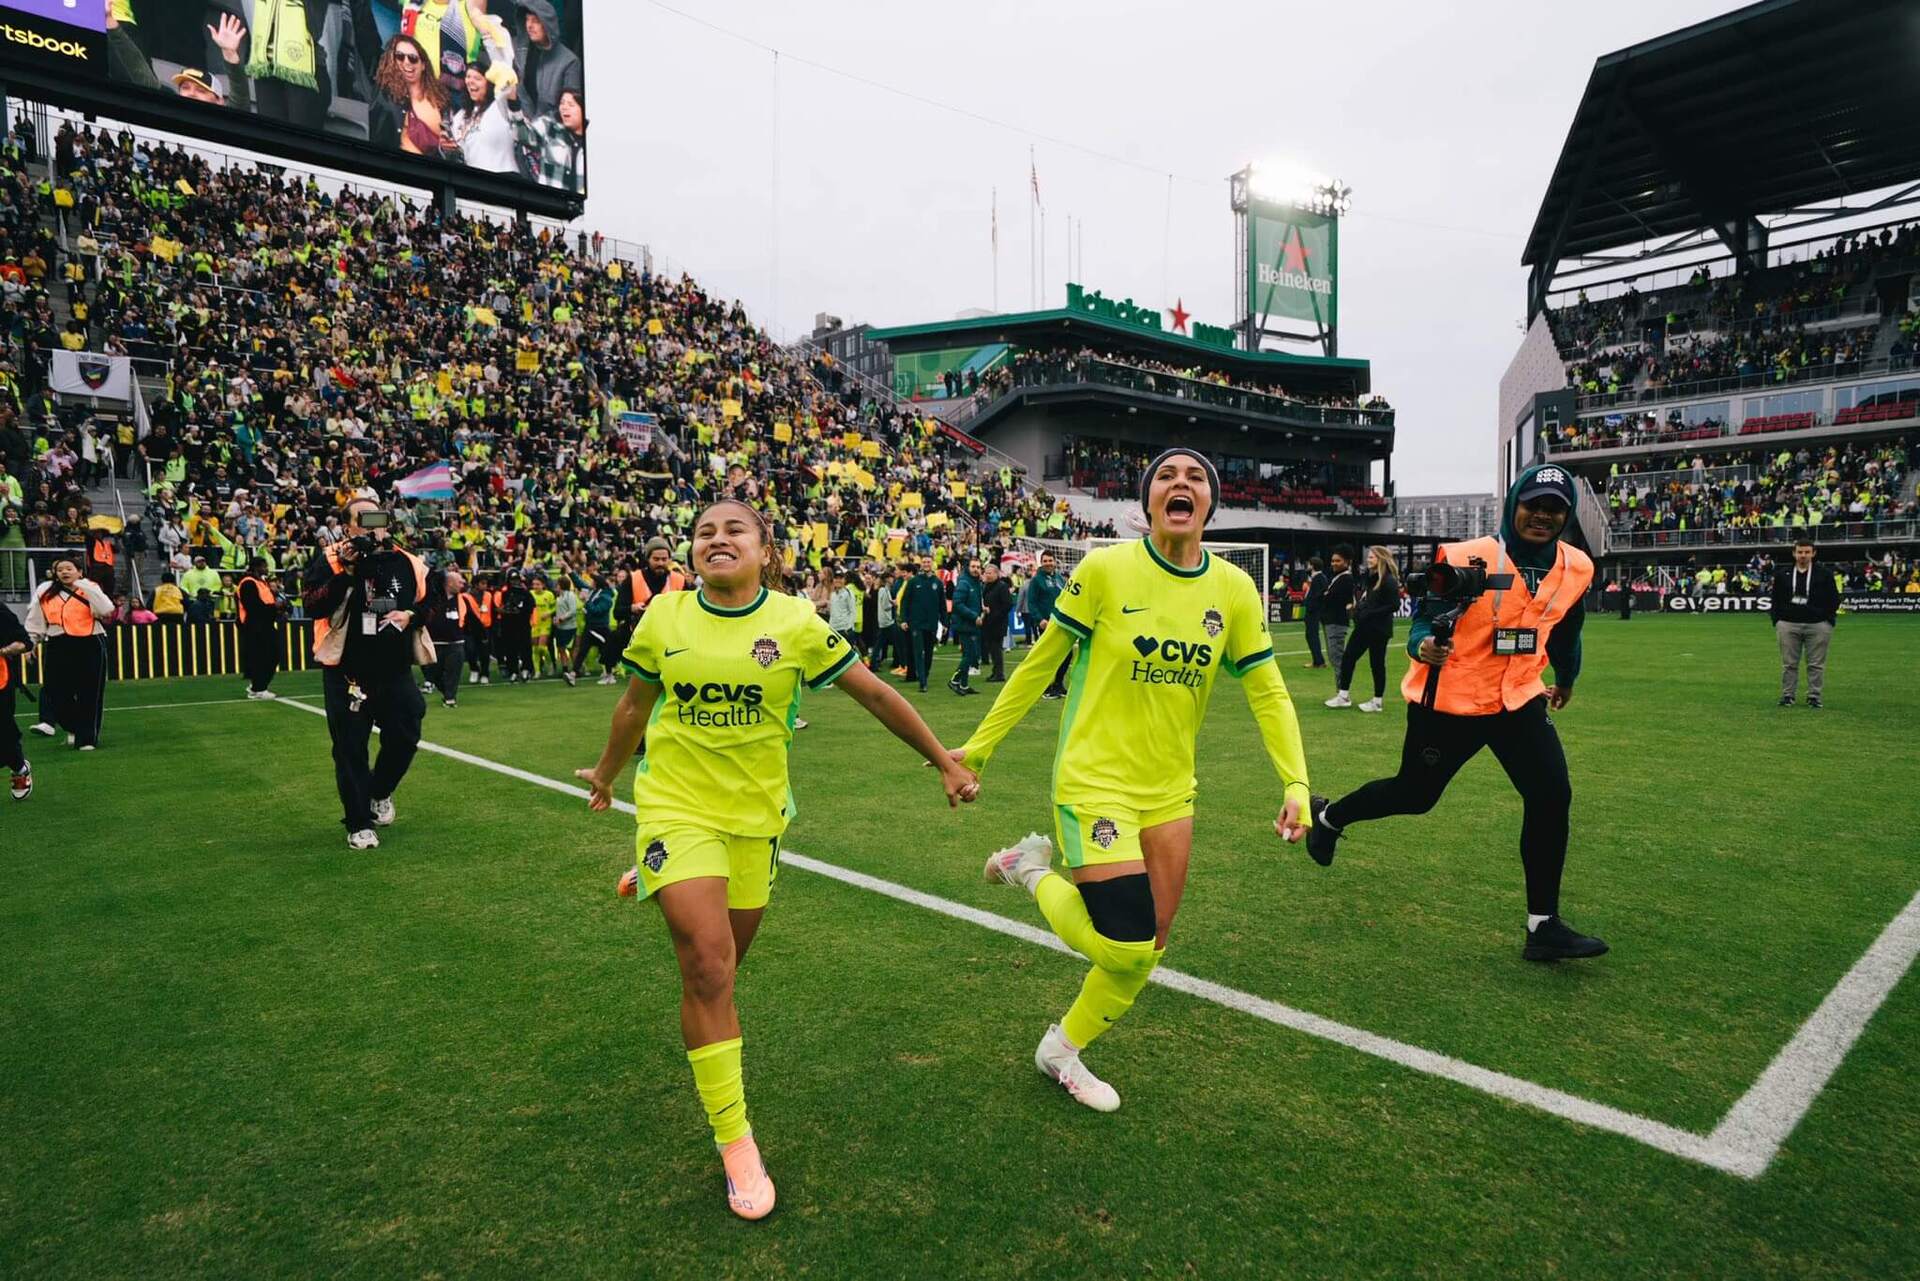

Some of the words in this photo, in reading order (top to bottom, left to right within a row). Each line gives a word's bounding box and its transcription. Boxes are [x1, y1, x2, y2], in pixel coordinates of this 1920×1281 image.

[1258, 262, 1332, 295] Heineken
[1881, 603, 1914, 611] Planning
[1161, 639, 1213, 667] CVS
[1130, 660, 1203, 688] Health
[700, 682, 763, 707] CVS
[678, 703, 763, 728] Health
